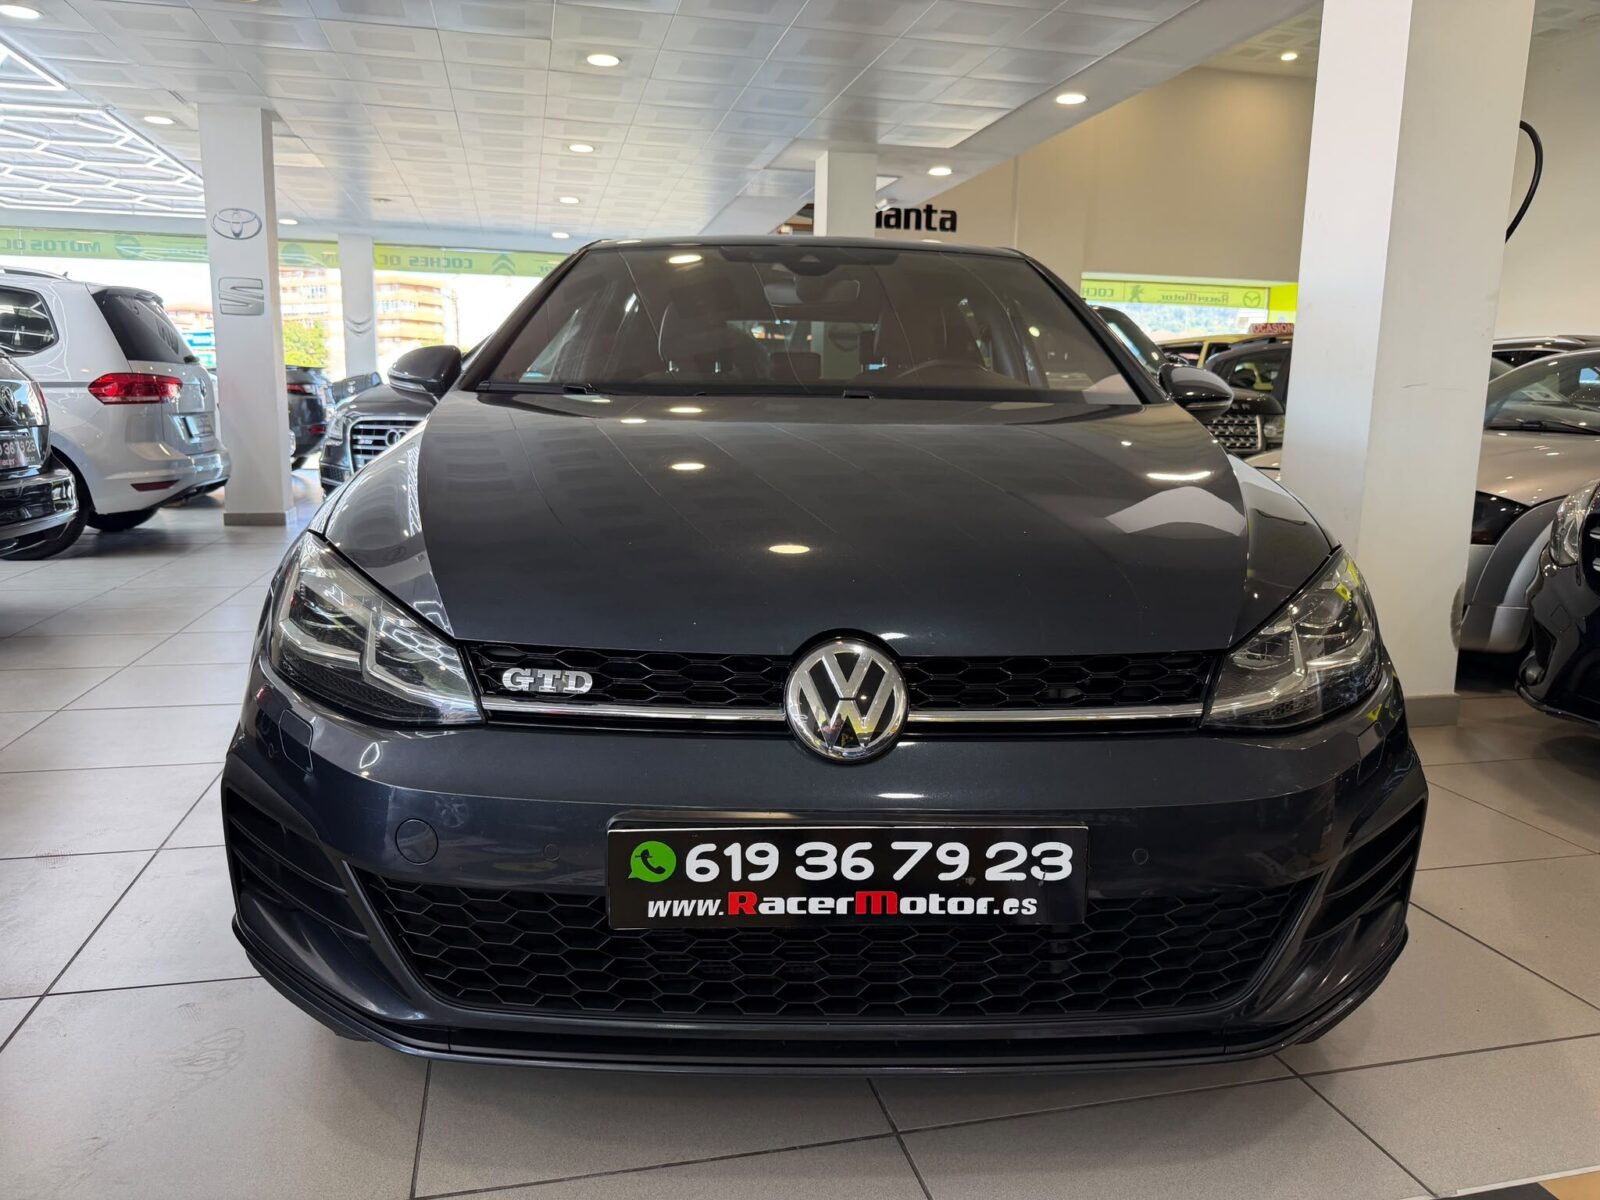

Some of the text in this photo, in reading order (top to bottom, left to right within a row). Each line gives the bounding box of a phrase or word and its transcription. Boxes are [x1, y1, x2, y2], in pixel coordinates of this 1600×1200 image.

[501, 667, 593, 695] GTD
[685, 841, 1074, 883] 619 36 79 23
[647, 890, 1038, 918] www.RacerMotor.es
